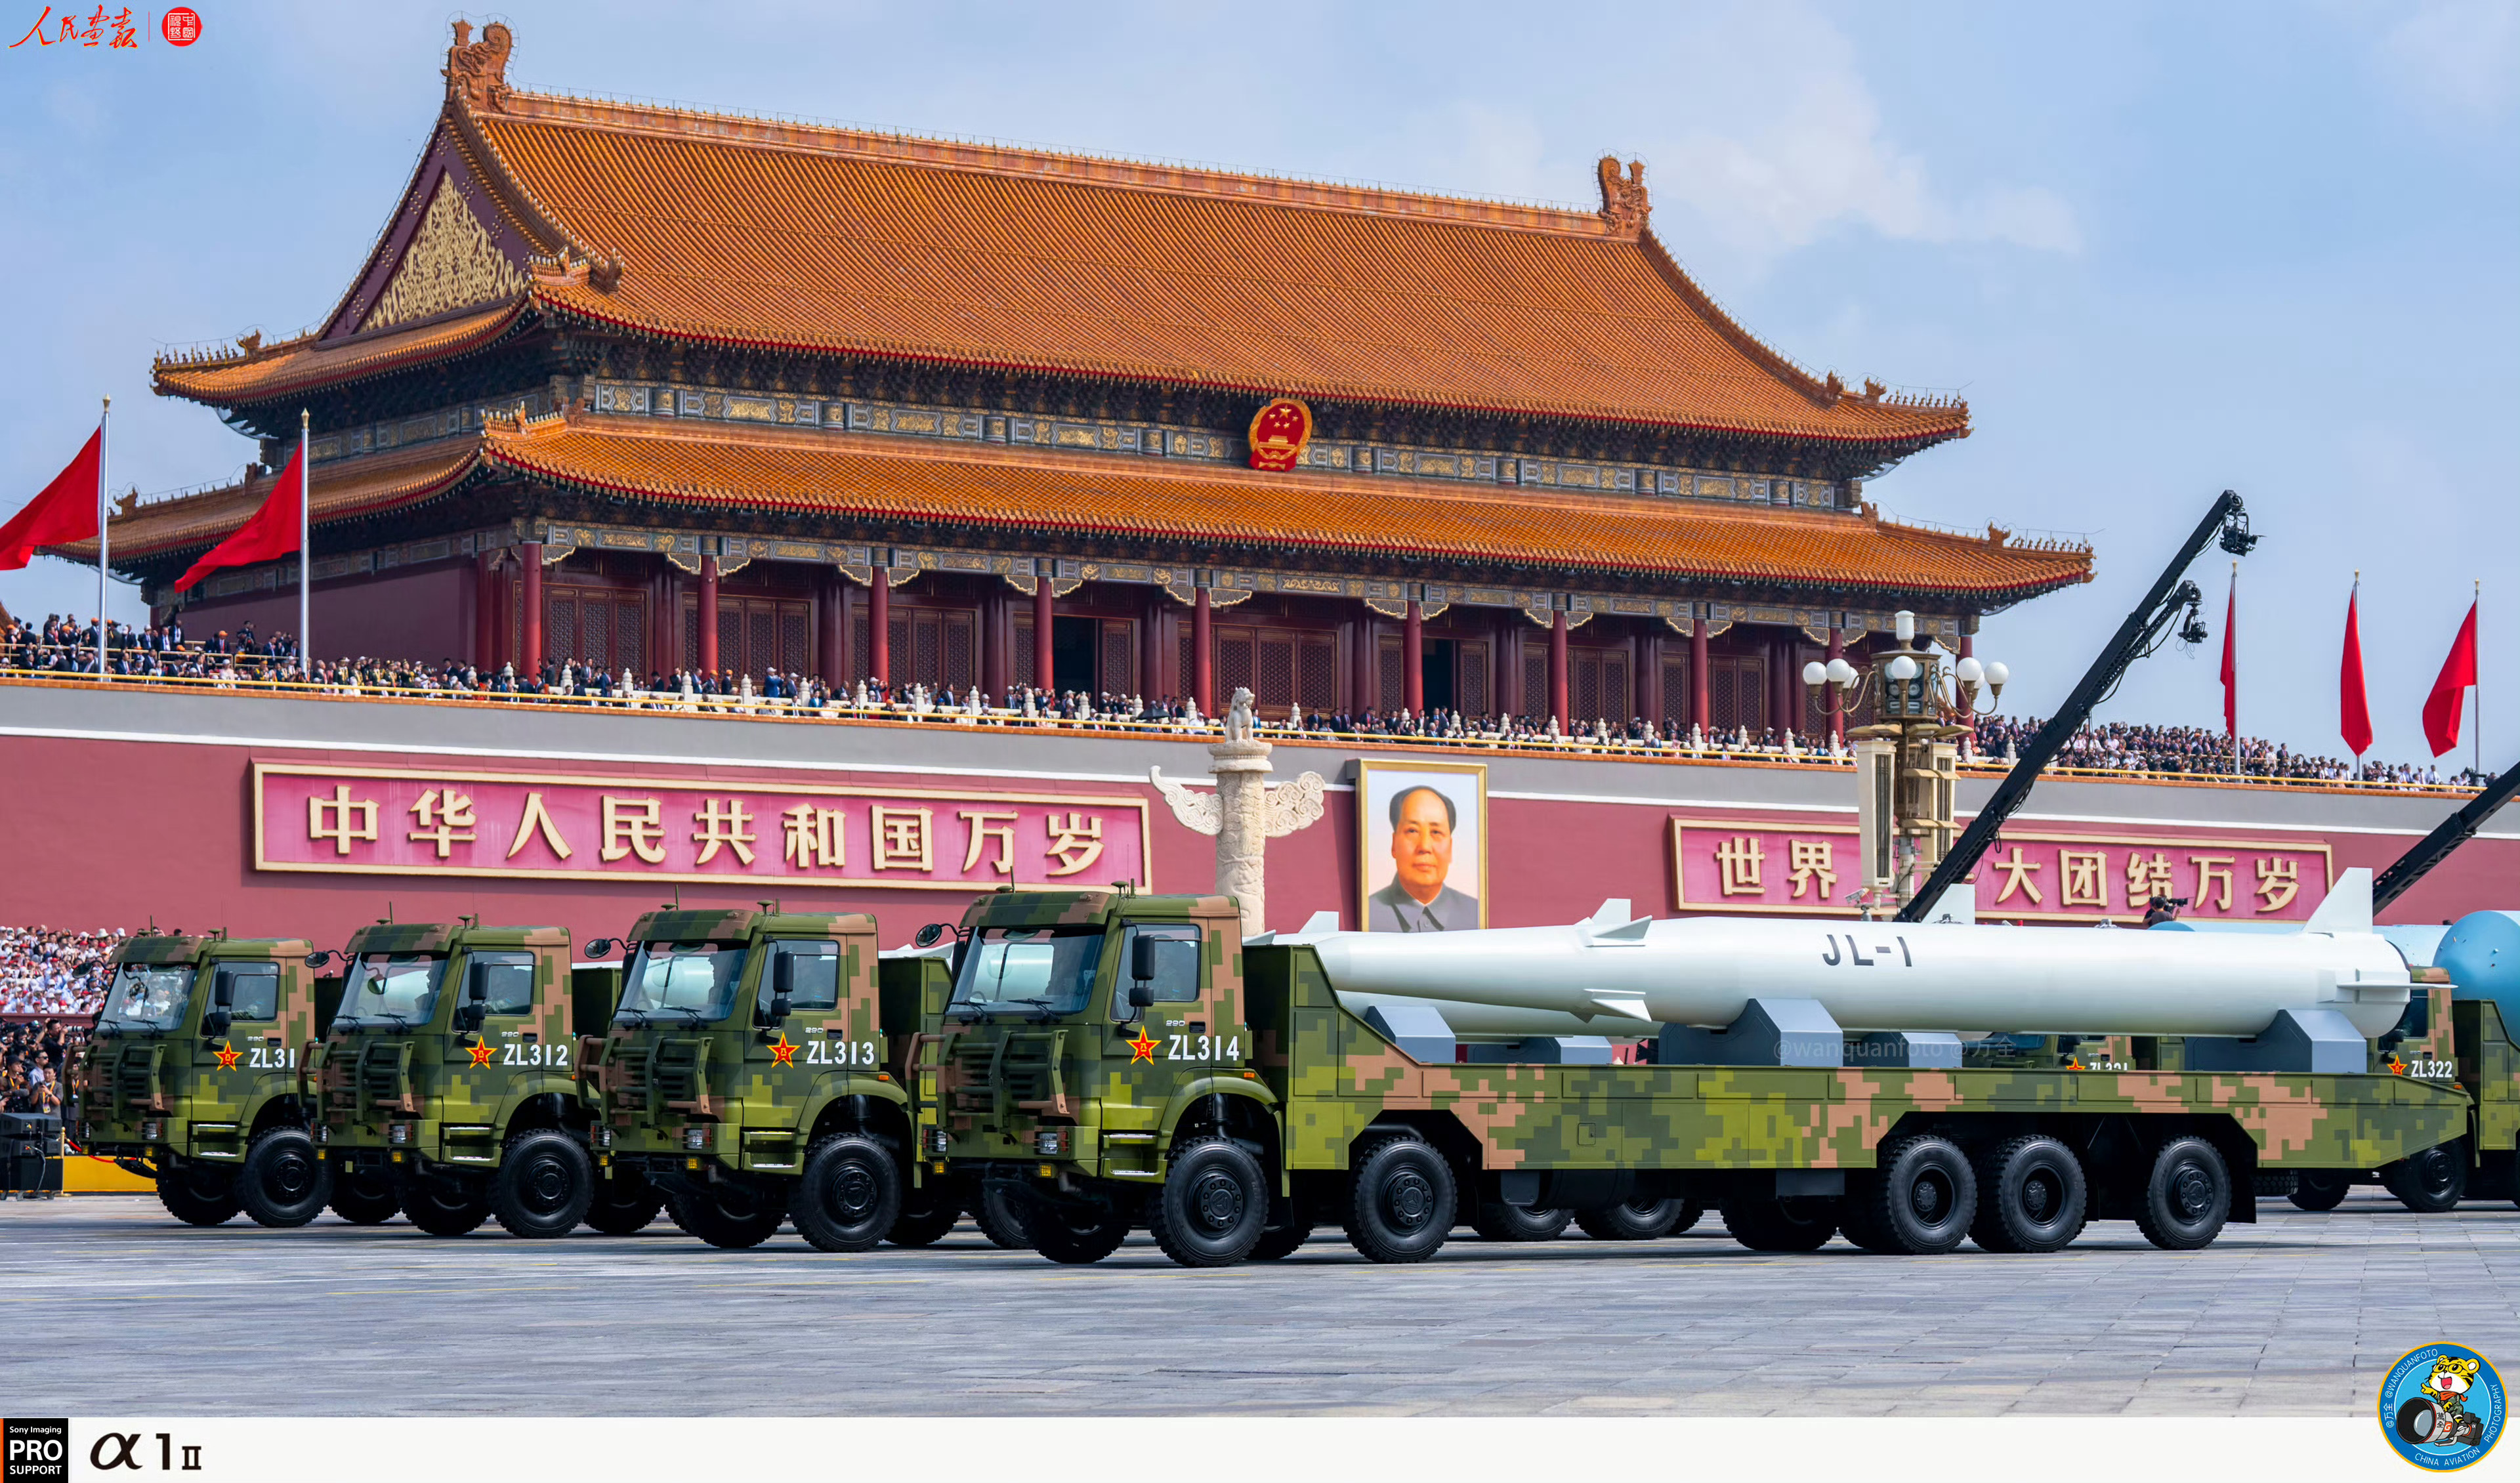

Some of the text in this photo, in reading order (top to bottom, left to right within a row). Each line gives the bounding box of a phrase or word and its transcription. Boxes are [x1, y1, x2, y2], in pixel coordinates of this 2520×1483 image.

[309, 785, 1105, 877] 中华人民共和国万岁
[1714, 837, 2300, 913] 世界大团结万岁
[1822, 934, 1912, 967] JL-1
[503, 1043, 568, 1066] ZL312
[806, 1040, 875, 1065] ZL313
[1168, 1034, 1240, 1061] ZL314
[2410, 1060, 2453, 1078] ZL322
